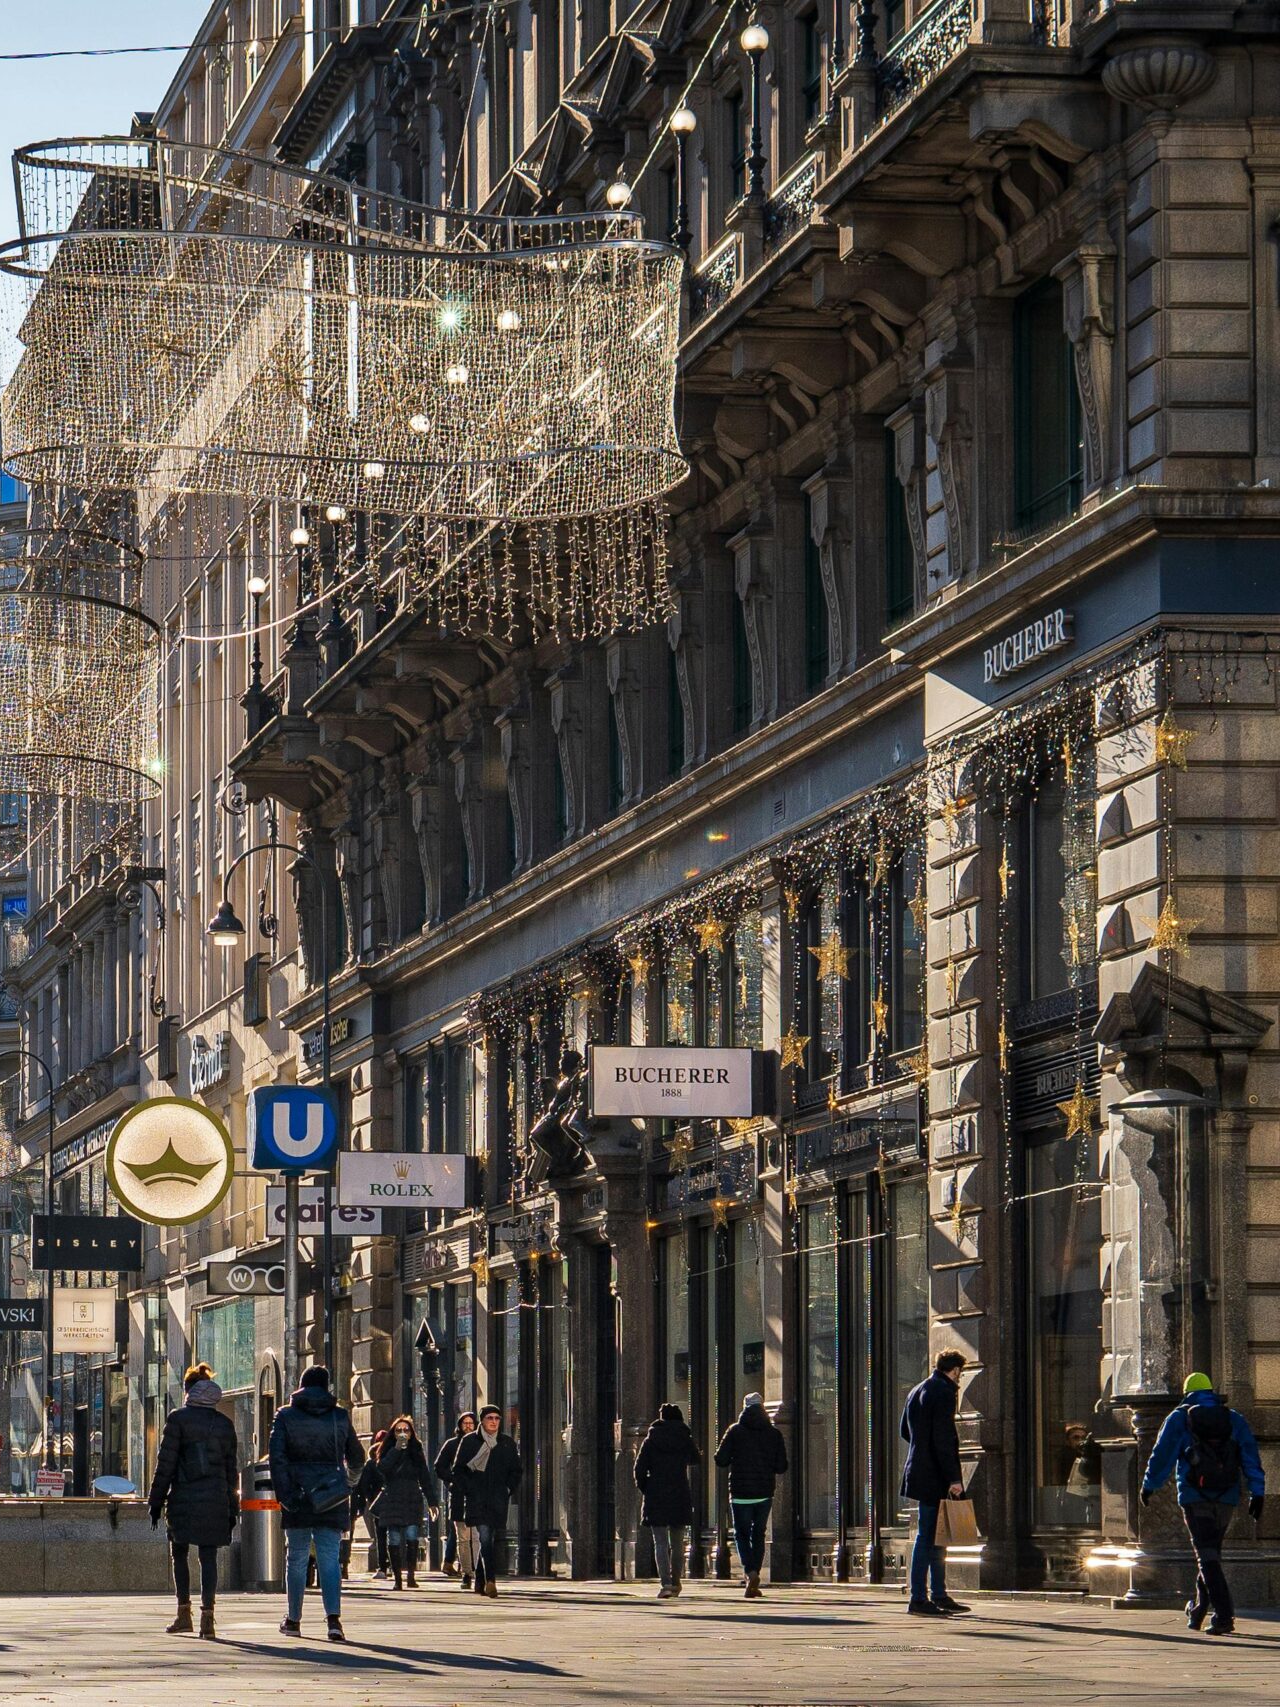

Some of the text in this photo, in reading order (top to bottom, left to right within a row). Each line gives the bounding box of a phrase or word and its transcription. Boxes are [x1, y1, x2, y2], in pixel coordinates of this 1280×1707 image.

[983, 608, 1066, 684] BUCHERER
[614, 1067, 730, 1084] BUCHERER
[1035, 1063, 1088, 1096] BUCHERR
[661, 1088, 682, 1098] 1888
[273, 1102, 324, 1158] U
[369, 1183, 435, 1198] ROLEX
[274, 1196, 376, 1223] caies
[37, 1238, 136, 1249] SISLEY
